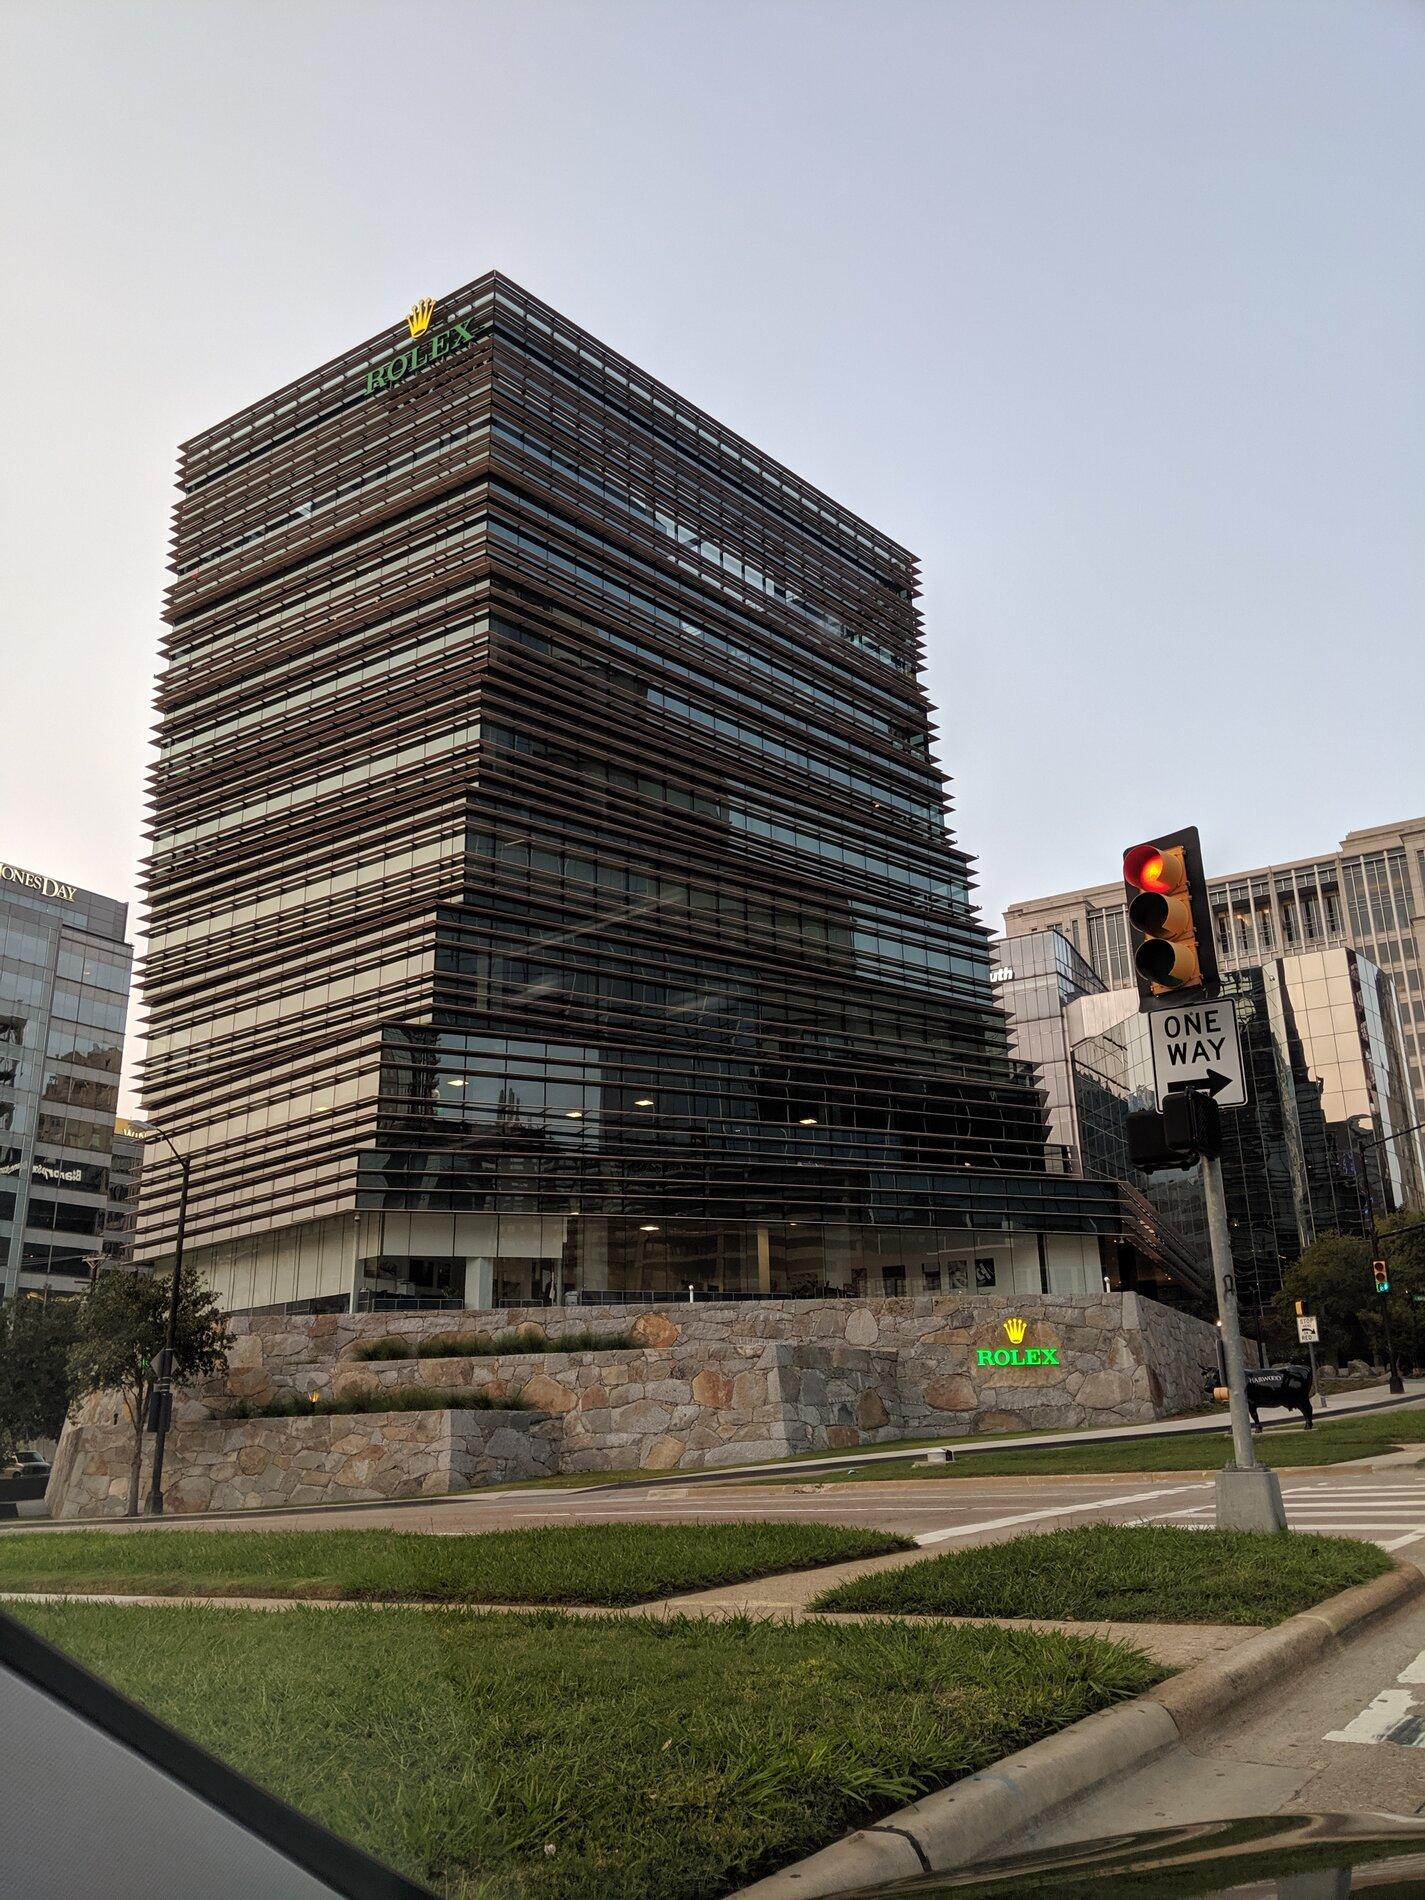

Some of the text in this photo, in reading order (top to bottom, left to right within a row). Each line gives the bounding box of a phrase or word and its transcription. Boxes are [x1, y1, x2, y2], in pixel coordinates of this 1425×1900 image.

[364, 316, 475, 396] ROLEX
[1164, 1009, 1222, 1039] ONE
[1166, 1036, 1226, 1066] WAY
[976, 1347, 1060, 1367] ROLEX
[1248, 1375, 1282, 1384] HARWOOD
